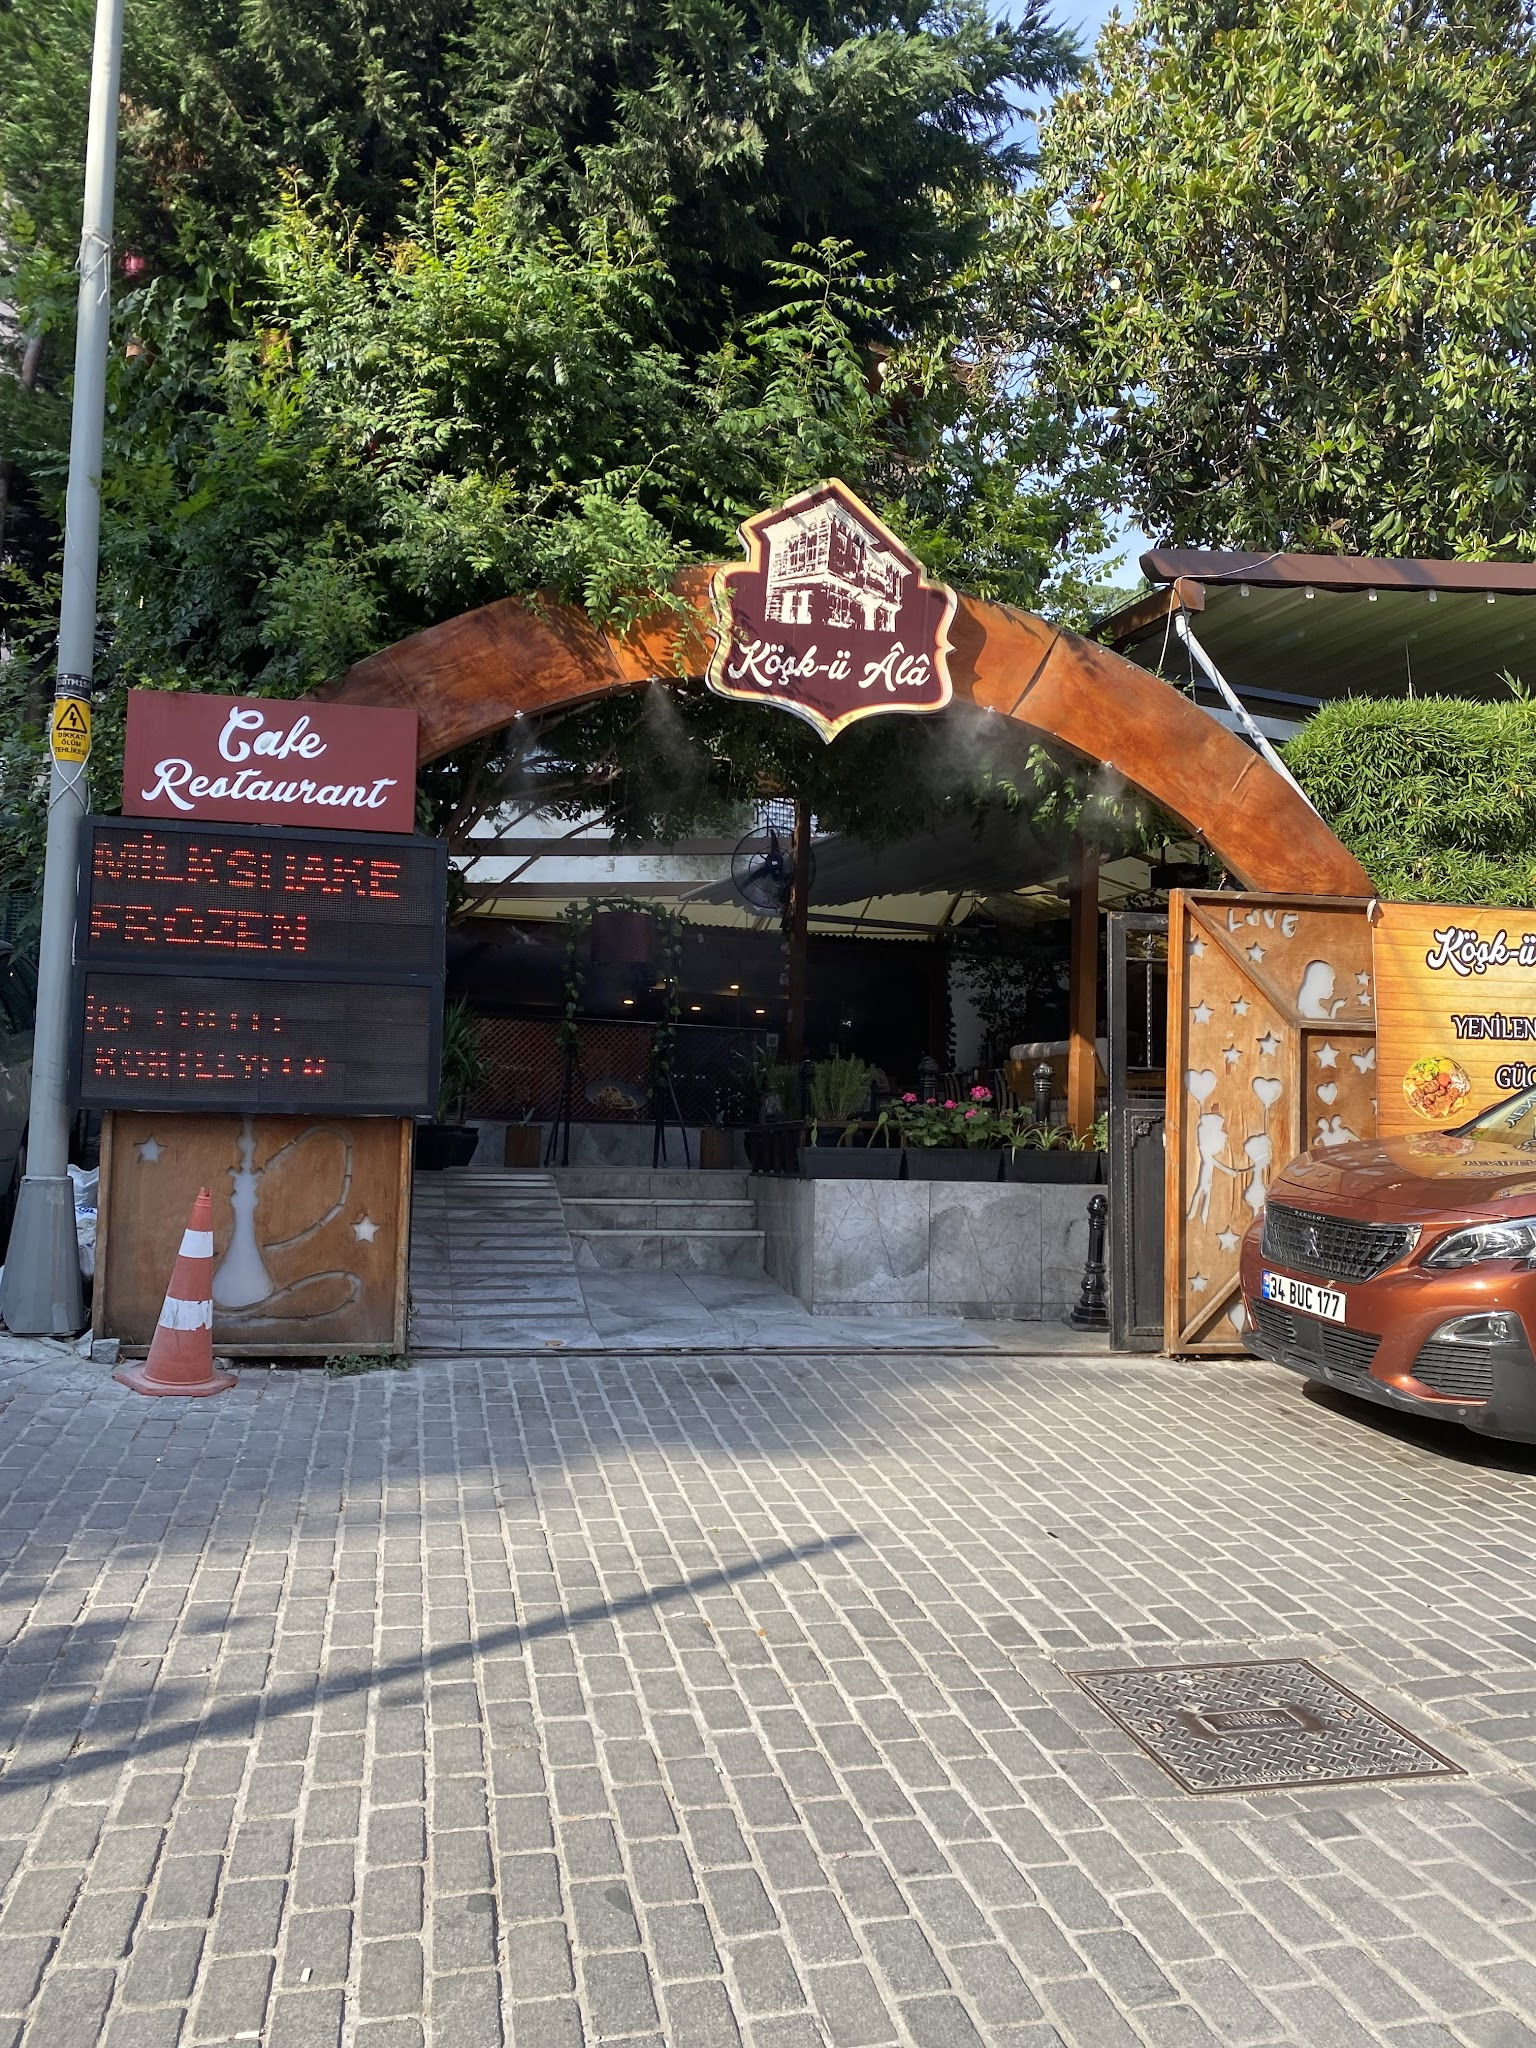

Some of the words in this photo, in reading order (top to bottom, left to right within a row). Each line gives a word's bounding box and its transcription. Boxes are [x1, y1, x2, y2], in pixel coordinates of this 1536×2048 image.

[728, 639, 851, 688] Köşk-ü
[858, 641, 931, 692] Âlâ
[219, 705, 327, 763] Cafe
[142, 758, 398, 812] Restaurant
[93, 833, 401, 899] MİLKSHAKE
[91, 904, 307, 952] FROZEN
[1226, 908, 1299, 938] LOVE
[1271, 1277, 1285, 1301] 34
[1289, 1282, 1313, 1309] BUC
[1317, 1290, 1340, 1317] 177
